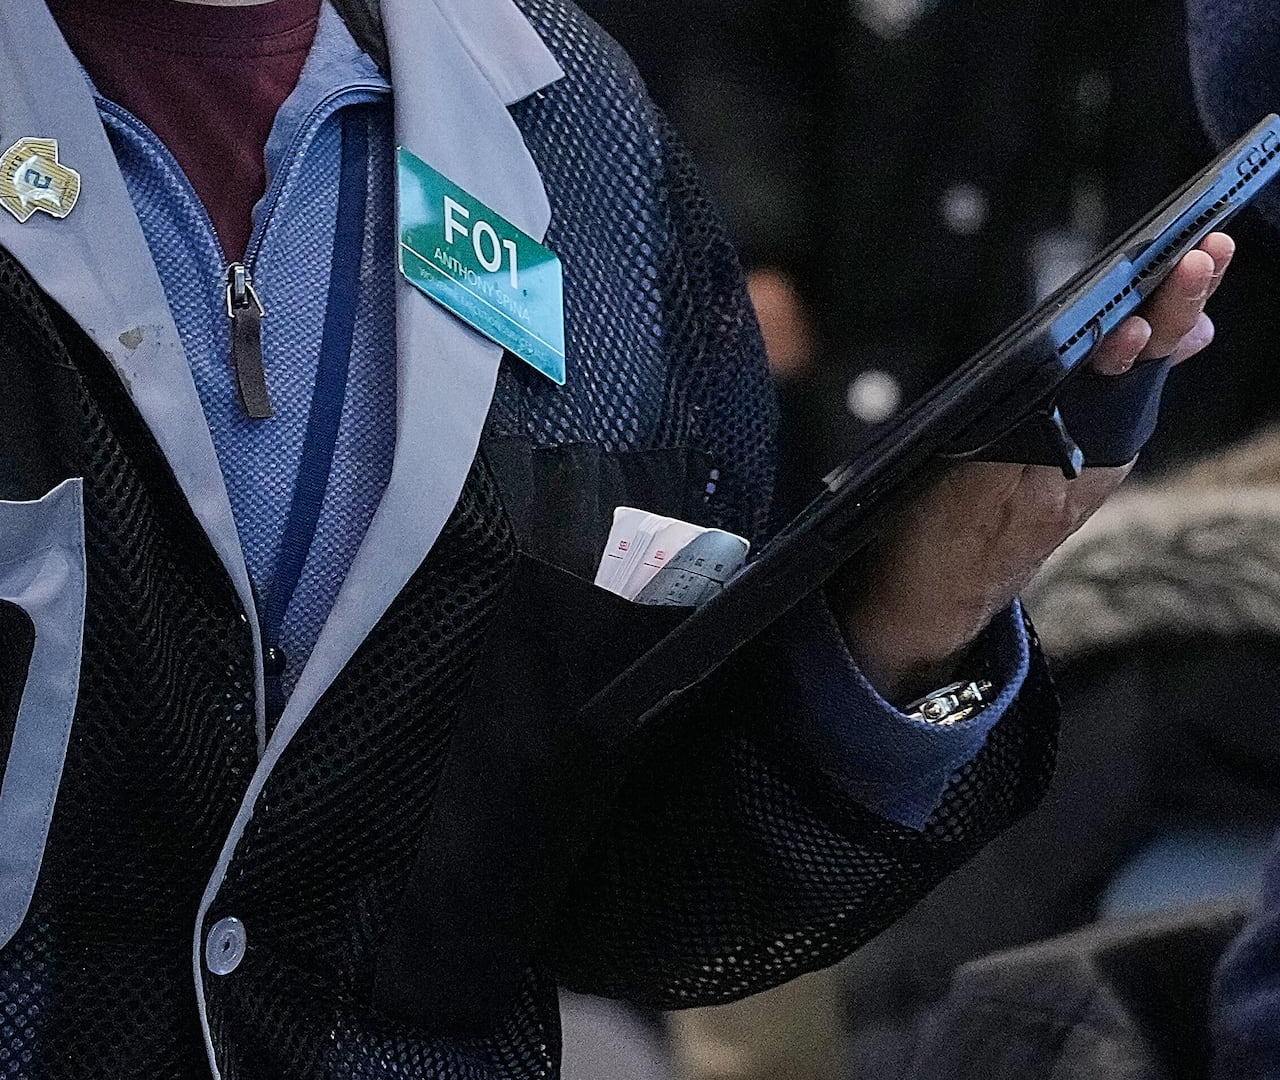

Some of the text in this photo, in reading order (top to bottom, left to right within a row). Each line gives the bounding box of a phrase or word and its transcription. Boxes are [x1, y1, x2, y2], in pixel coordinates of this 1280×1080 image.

[24, 168, 52, 189] 2
[443, 195, 518, 289] F01
[433, 247, 494, 297] ANTHONY
